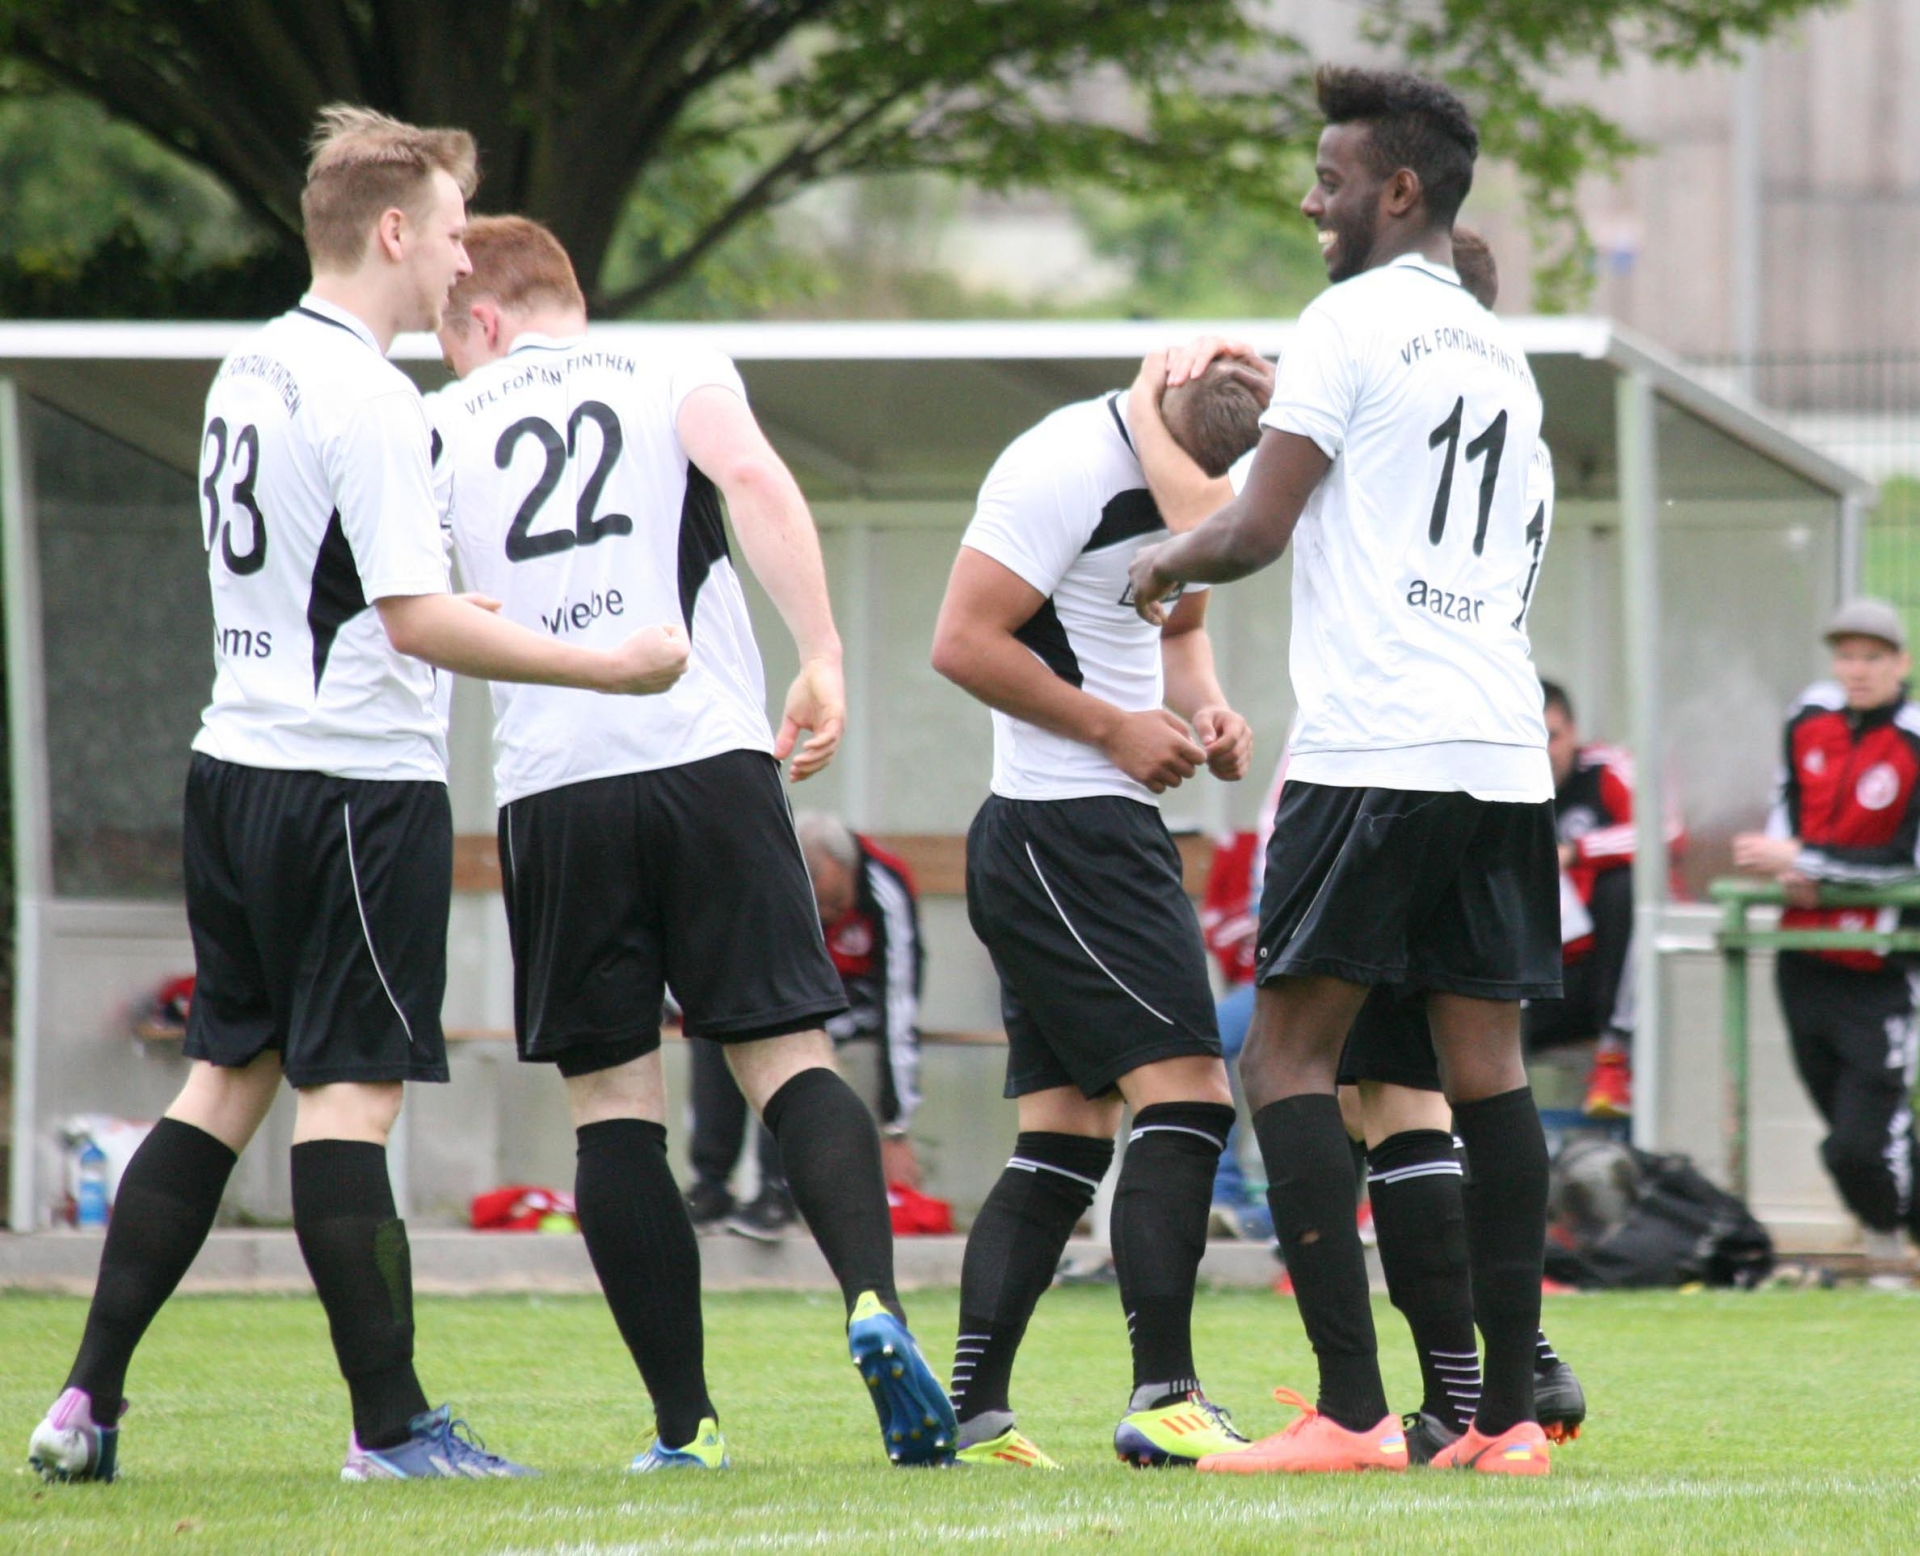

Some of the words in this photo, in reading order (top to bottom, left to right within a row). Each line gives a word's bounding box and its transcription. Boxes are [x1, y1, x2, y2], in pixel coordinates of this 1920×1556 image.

[1401, 334, 1432, 365] VFL
[1435, 327, 1488, 358] FONTANA
[465, 390, 497, 416] VFL
[503, 364, 563, 395] FONTAN
[567, 352, 636, 376] FINTHEN
[202, 416, 268, 576] 33
[495, 400, 633, 563] 22
[1428, 395, 1508, 558] 11
[1406, 579, 1485, 624] aazar
[215, 627, 272, 659] ms
